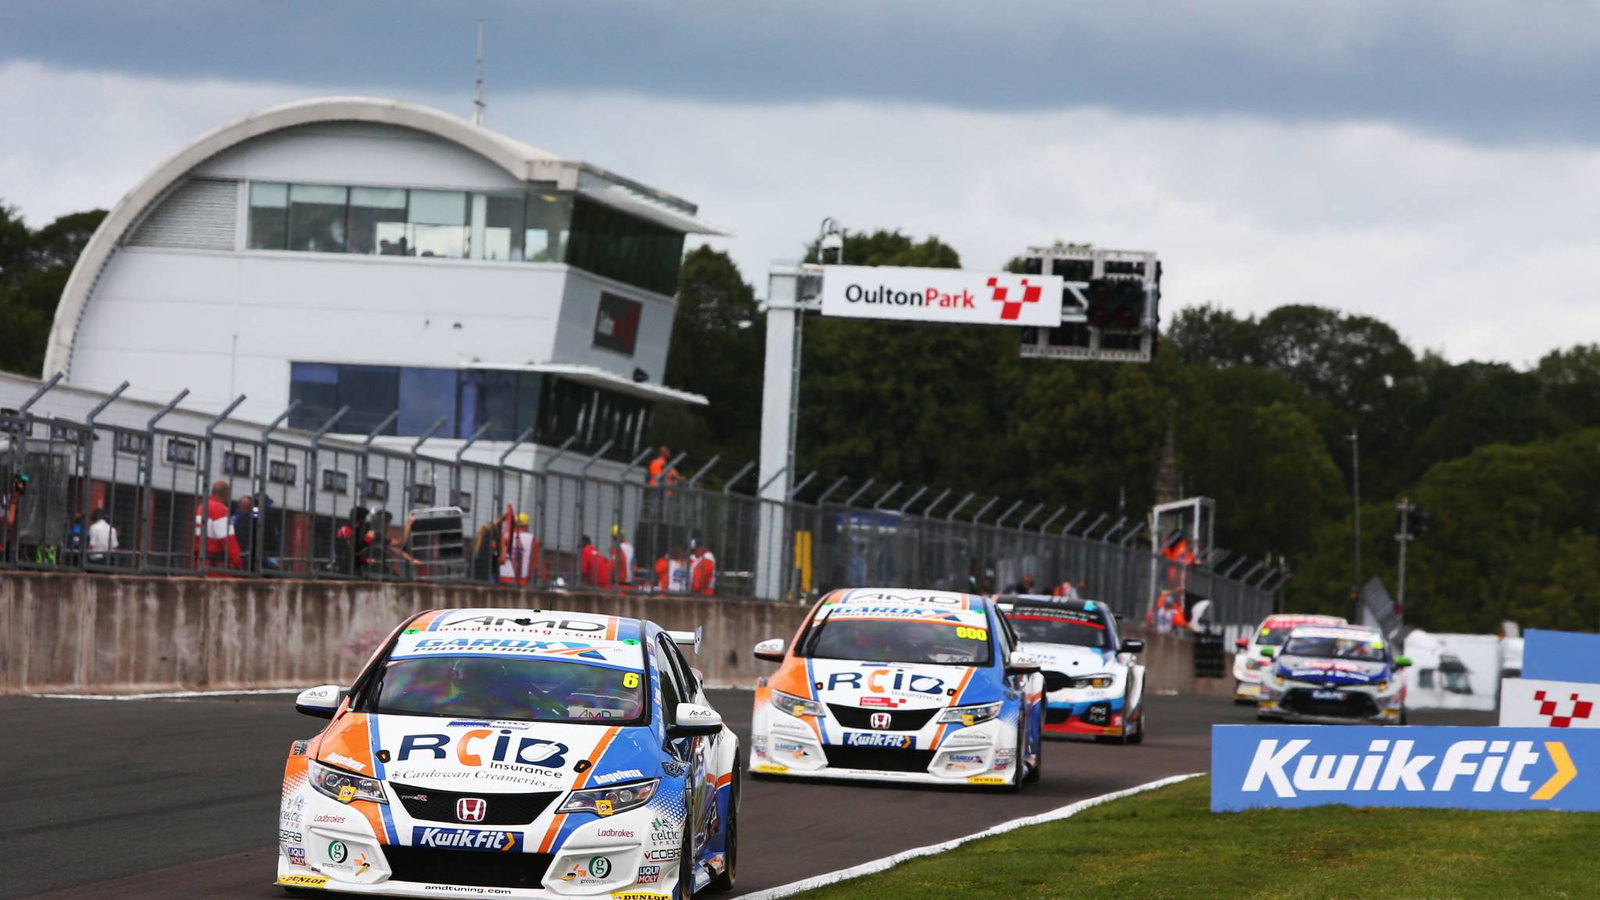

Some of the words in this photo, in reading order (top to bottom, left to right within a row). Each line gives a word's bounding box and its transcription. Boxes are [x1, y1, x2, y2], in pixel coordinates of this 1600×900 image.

[956, 627, 987, 641] 600
[622, 672, 639, 688] 6
[490, 762, 563, 779] Insurance
[403, 769, 471, 780] Cardowan
[475, 771, 547, 788] Creameries
[593, 769, 645, 785] Angelwax
[314, 814, 346, 824] Ladbrokes
[597, 828, 635, 838] Ladbrokes
[651, 830, 680, 841] celtic
[289, 848, 305, 857] LIQUI
[640, 866, 659, 875] LIQUI
[288, 876, 326, 884] DUNLOP
[638, 875, 658, 883] MOLY
[425, 885, 512, 894] amdtuning.com
